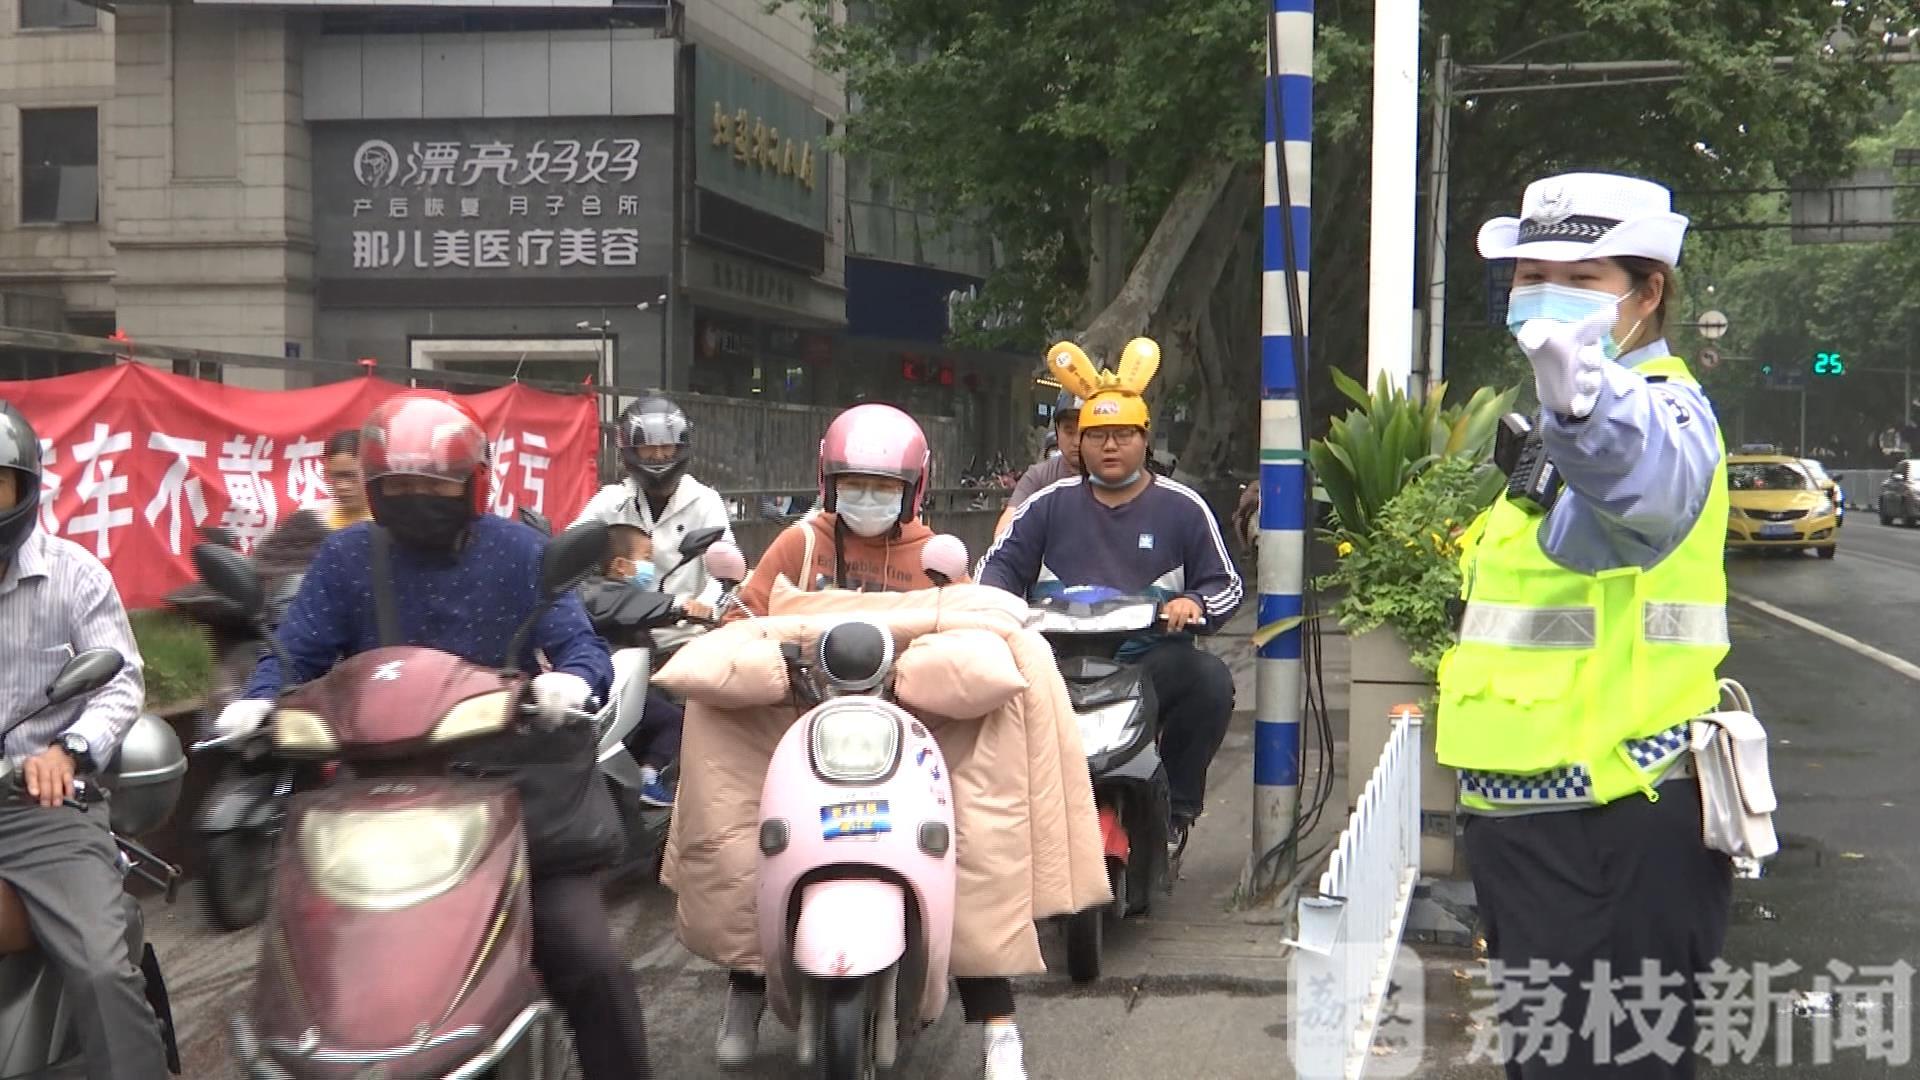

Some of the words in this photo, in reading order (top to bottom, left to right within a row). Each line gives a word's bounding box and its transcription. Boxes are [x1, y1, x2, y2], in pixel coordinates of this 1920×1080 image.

[401, 138, 641, 187] 漂亮妈妈
[352, 198, 480, 217] 产后恢复
[352, 228, 639, 268] 那儿美医疗美容
[1814, 353, 1843, 374] 25
